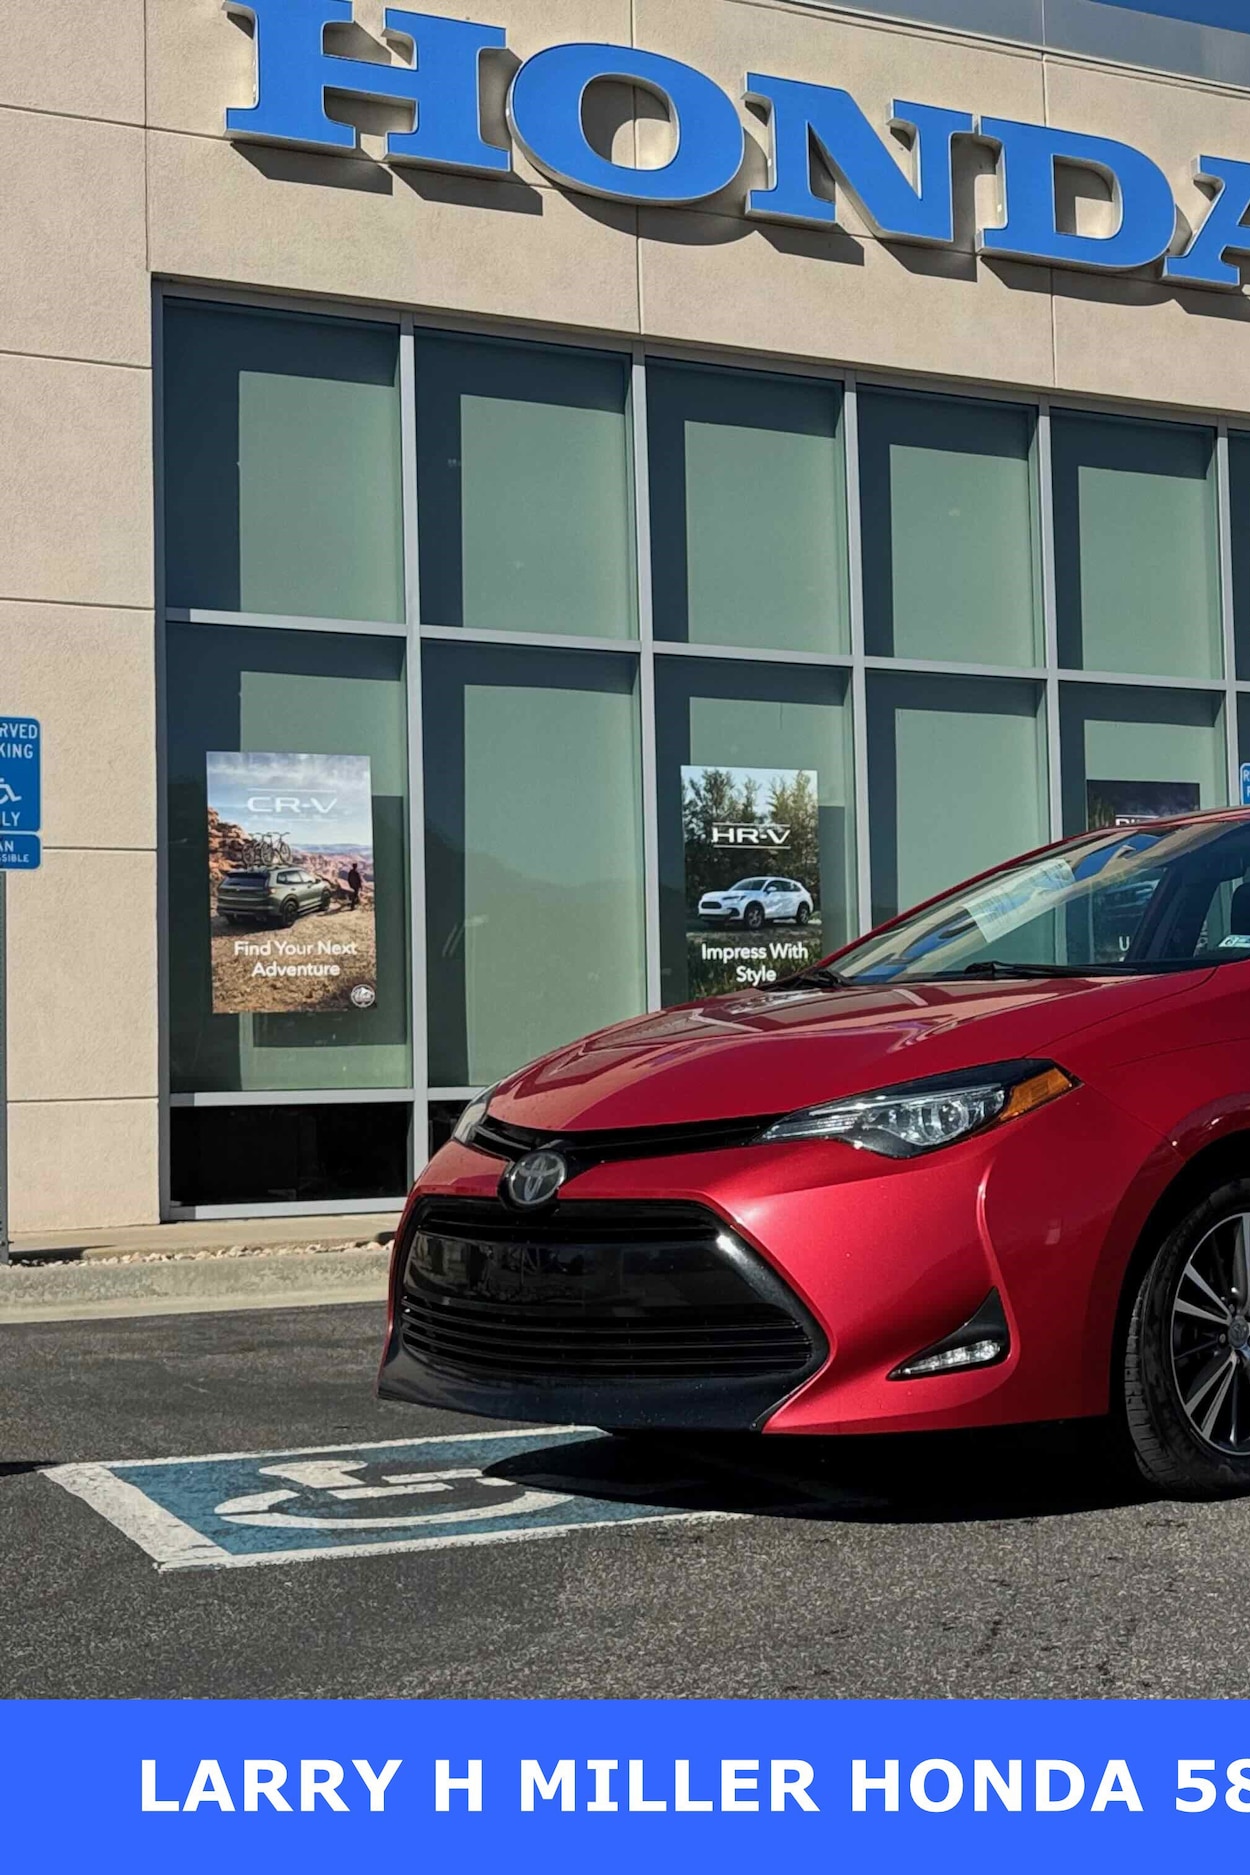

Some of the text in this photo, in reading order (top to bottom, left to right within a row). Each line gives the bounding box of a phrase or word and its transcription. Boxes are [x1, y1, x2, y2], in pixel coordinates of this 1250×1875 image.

[247, 796, 338, 814] CR-V
[711, 827, 791, 844] HR-V
[0, 853, 30, 863] SIBLE
[234, 940, 358, 956] Find Your Next
[701, 941, 809, 964] Impress With
[251, 961, 341, 977] Adventure
[736, 965, 777, 987] Style
